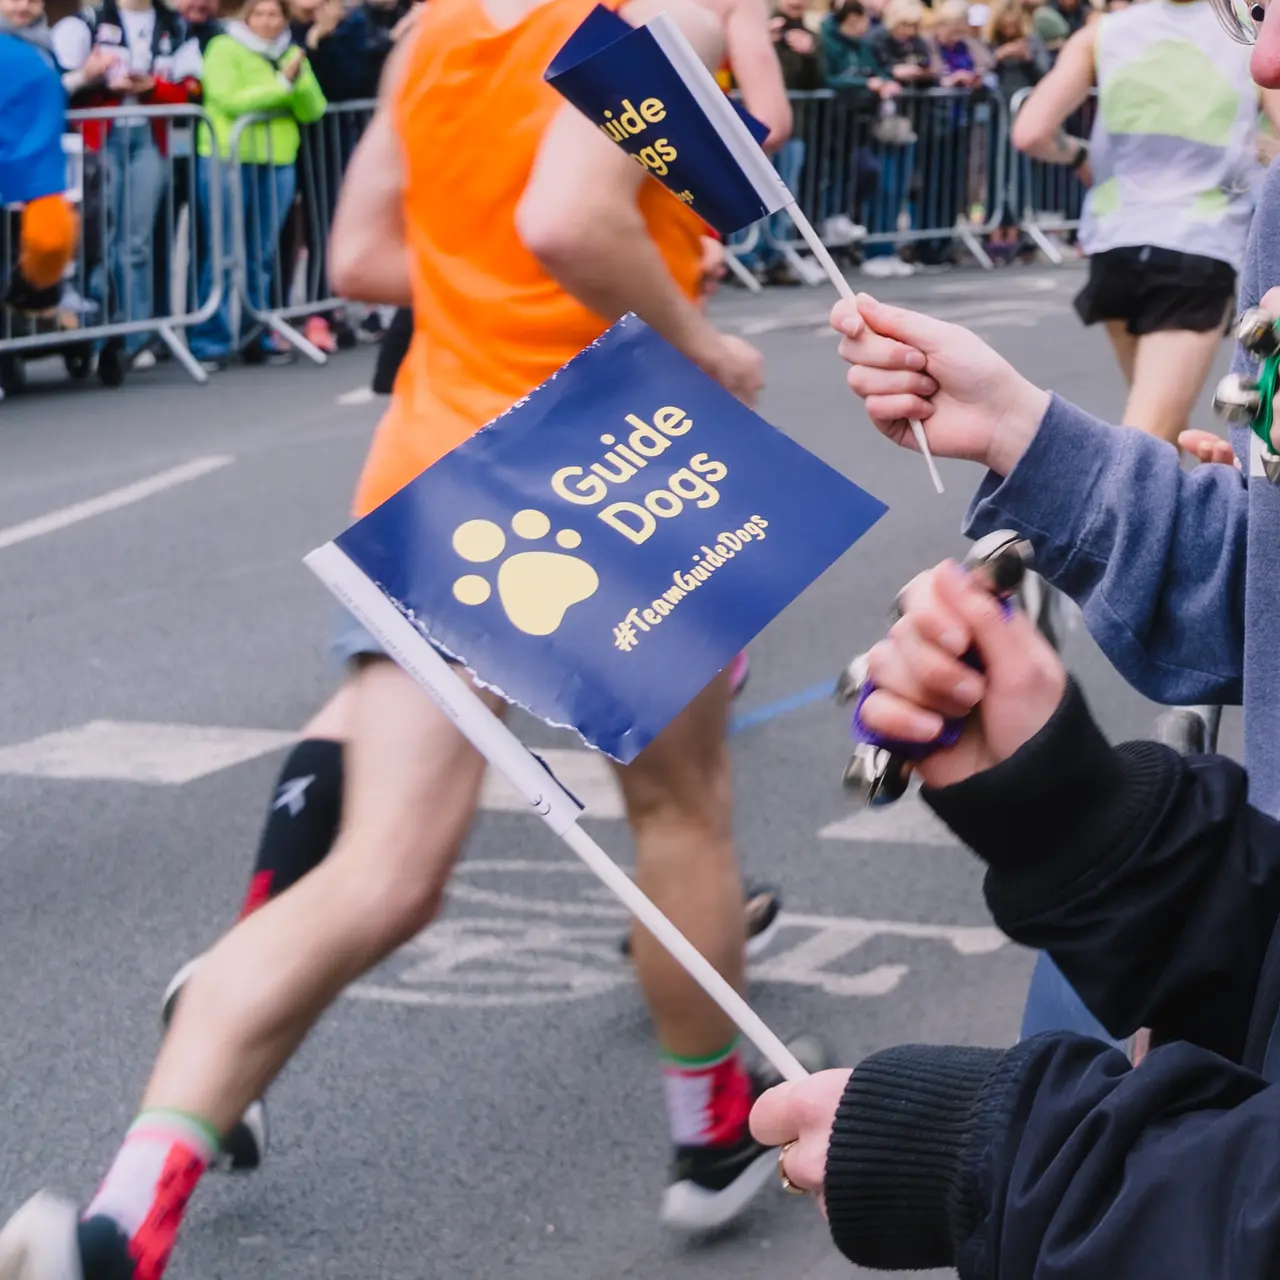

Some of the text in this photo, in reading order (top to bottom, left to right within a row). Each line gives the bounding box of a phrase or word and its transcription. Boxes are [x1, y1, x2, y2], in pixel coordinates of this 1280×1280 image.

[600, 97, 667, 142] uide
[629, 138, 678, 176] ogs
[551, 405, 693, 506] Guide
[597, 452, 728, 545] Dogs
[612, 514, 769, 653] #TeamGuideDogs
